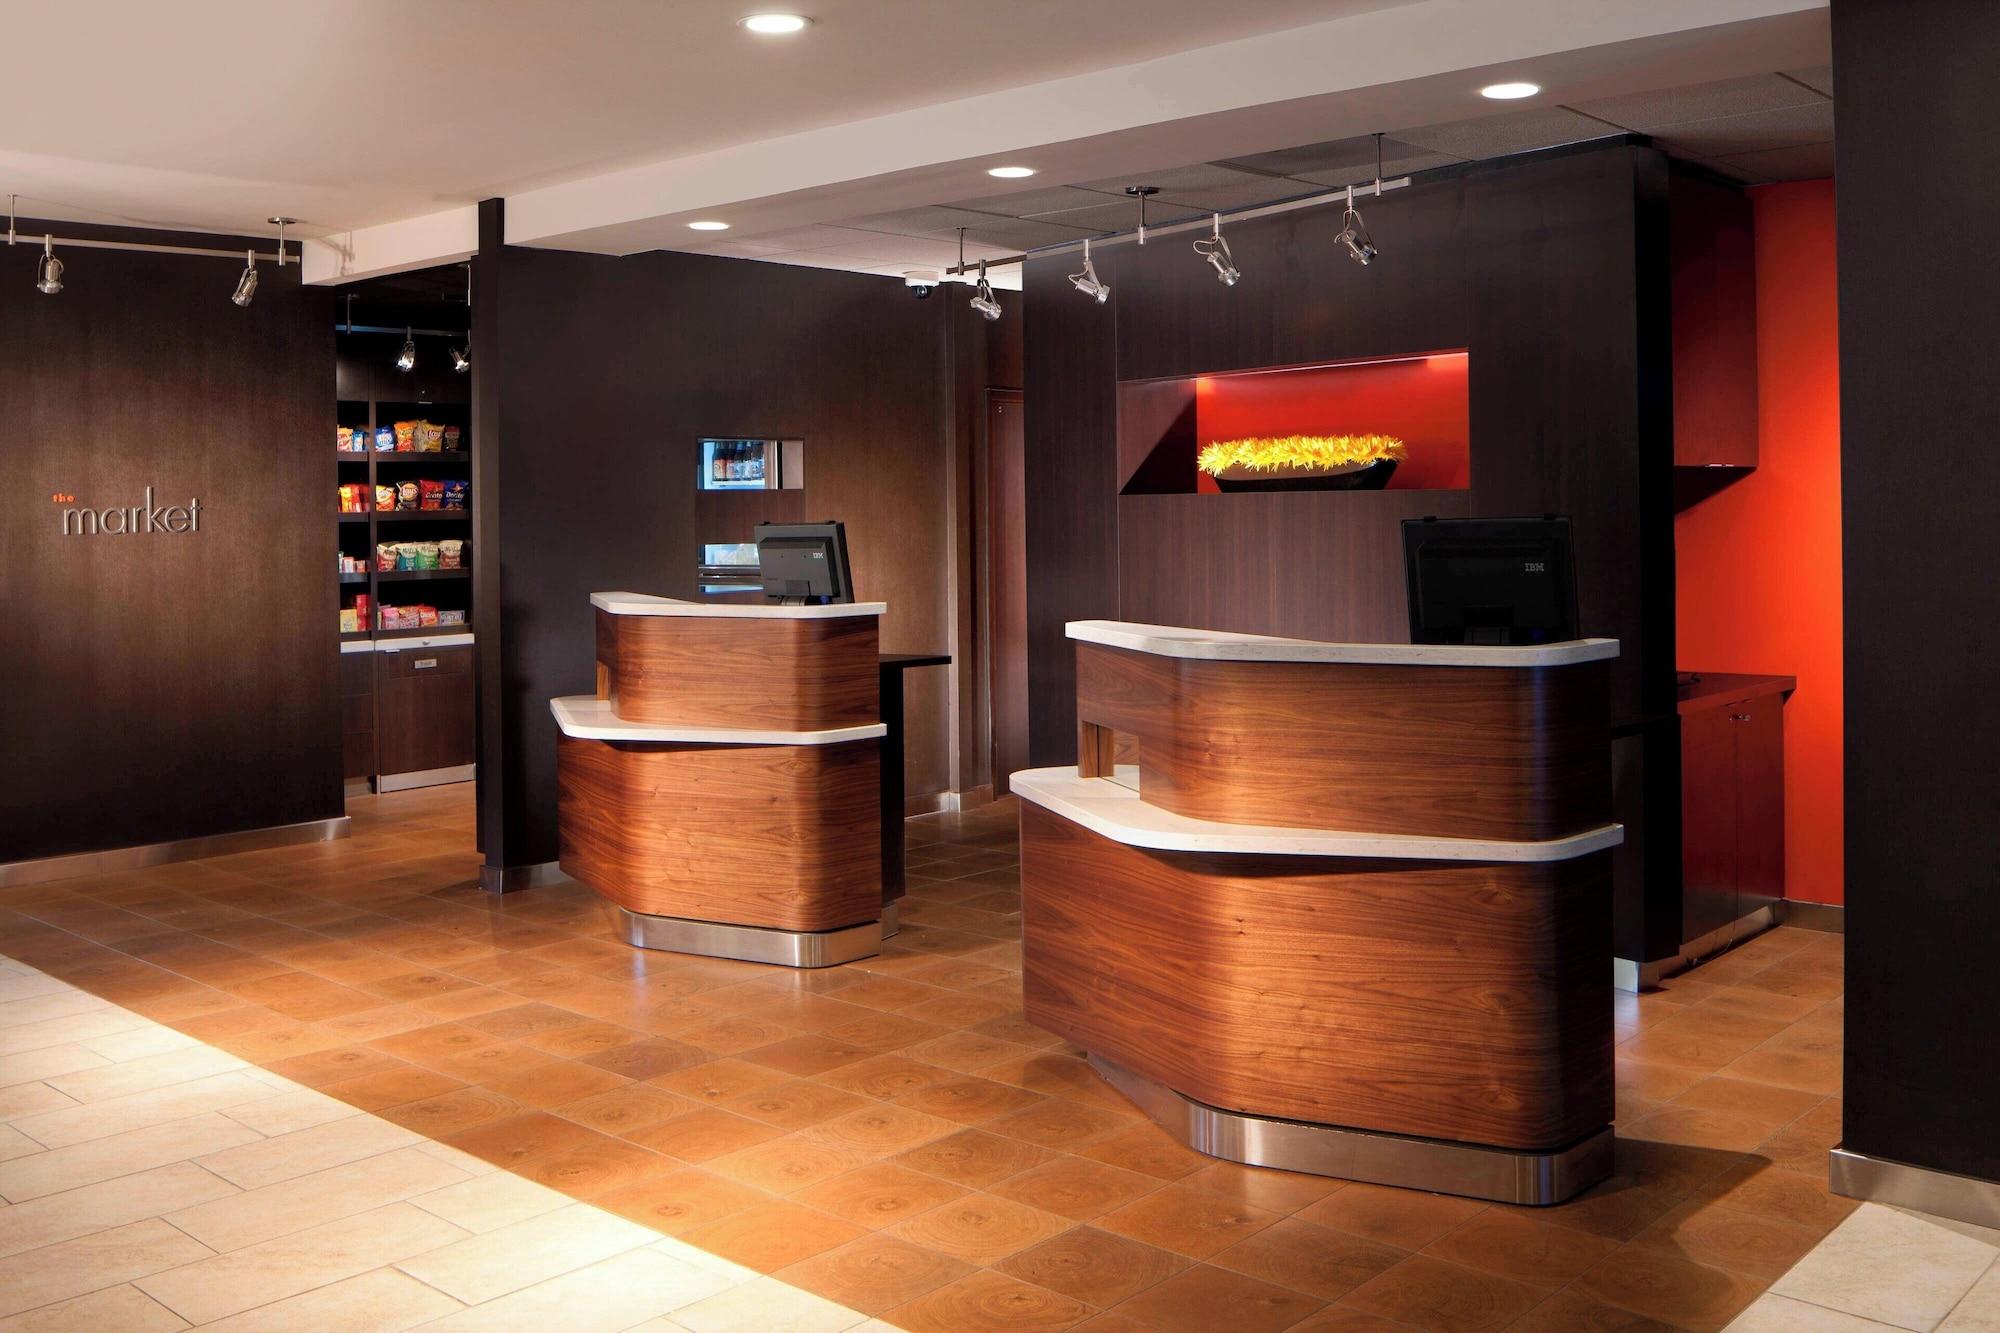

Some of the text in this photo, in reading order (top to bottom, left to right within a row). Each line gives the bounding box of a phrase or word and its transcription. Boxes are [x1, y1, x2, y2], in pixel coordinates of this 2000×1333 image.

[53, 493, 75, 503] the
[63, 486, 202, 534] market
[1524, 562, 1545, 572] IBM
